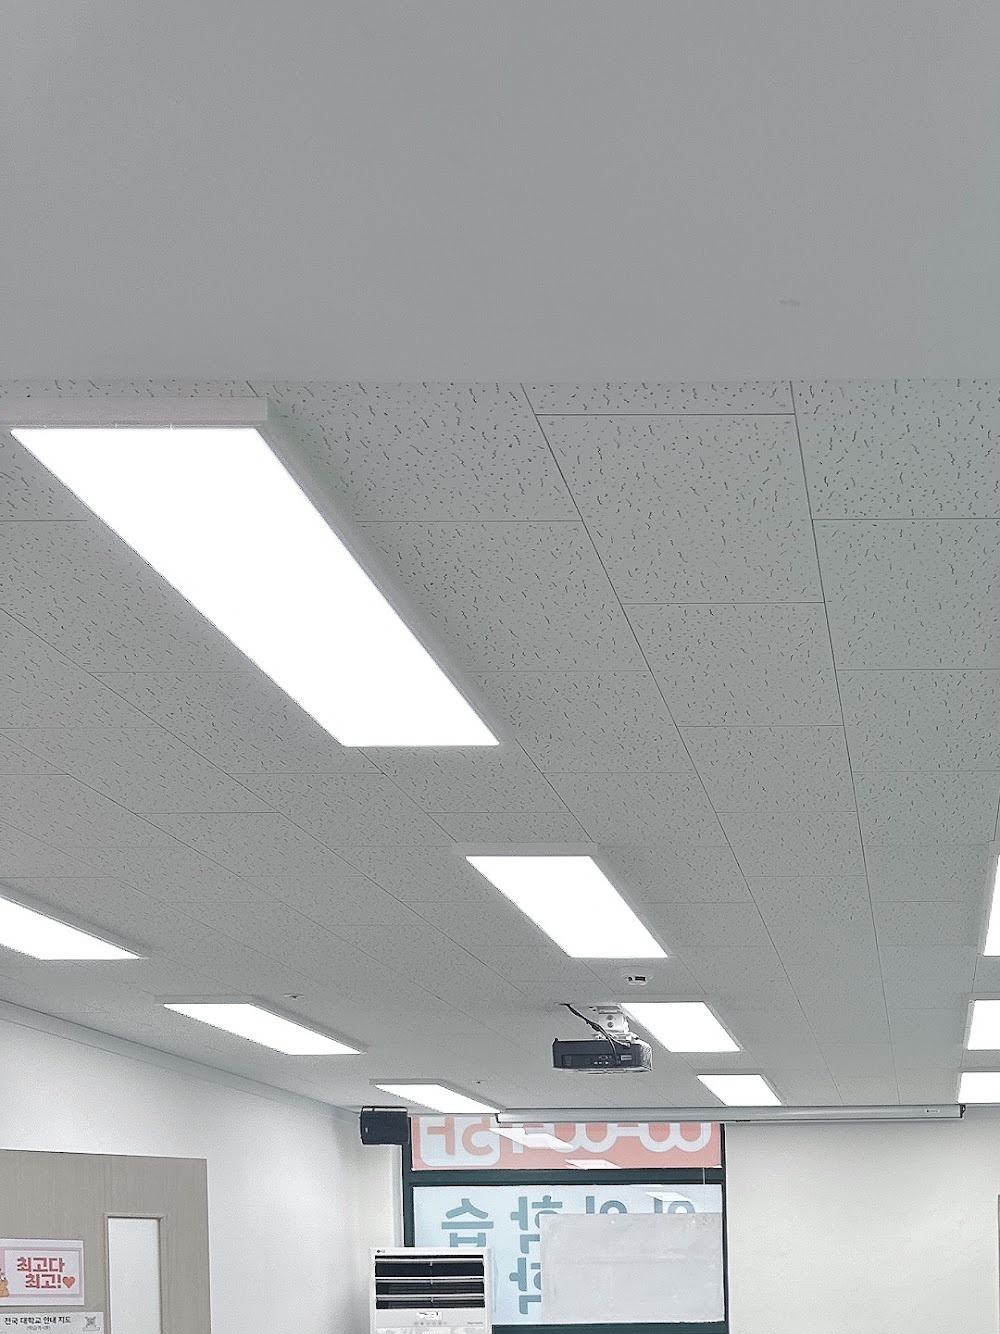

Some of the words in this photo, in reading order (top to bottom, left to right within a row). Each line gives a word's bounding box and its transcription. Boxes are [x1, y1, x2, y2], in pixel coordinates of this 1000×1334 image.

[17, 1256, 65, 1272] 최고다
[25, 1273, 61, 1289] 최고!
[20, 1316, 41, 1325] 대학교
